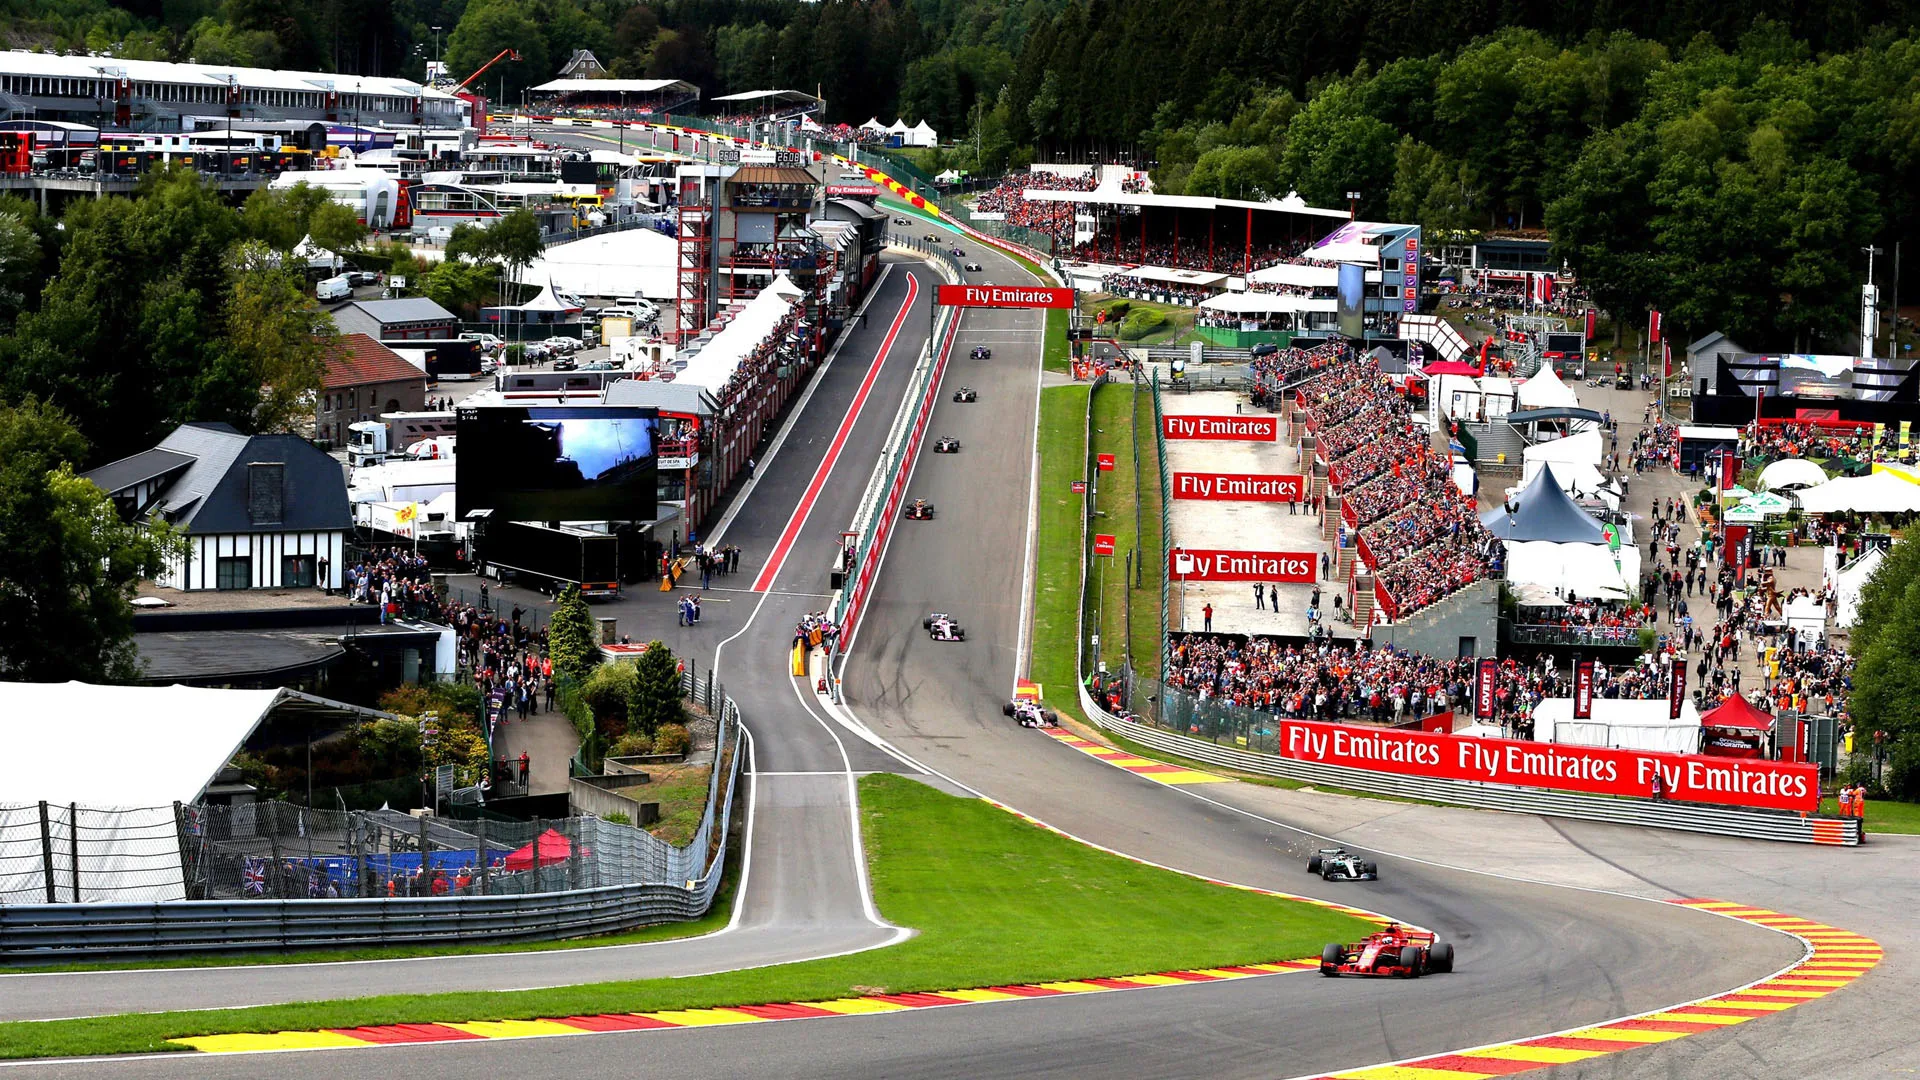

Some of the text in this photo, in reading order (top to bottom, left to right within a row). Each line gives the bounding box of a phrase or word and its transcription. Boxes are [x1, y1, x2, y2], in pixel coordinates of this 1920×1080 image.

[966, 288, 1053, 304] Fly Emirates
[1168, 418, 1271, 436] Fly Emirates
[1181, 476, 1297, 496] Fly Emirates
[1176, 554, 1309, 576] ly Emirates
[1581, 673, 1589, 684] IT
[1481, 671, 1491, 712] LOVE IT
[1289, 726, 1440, 765] Fly Emirates
[1458, 742, 1617, 782] Fly Emirates
[1637, 757, 1807, 797] Fly Emirates
